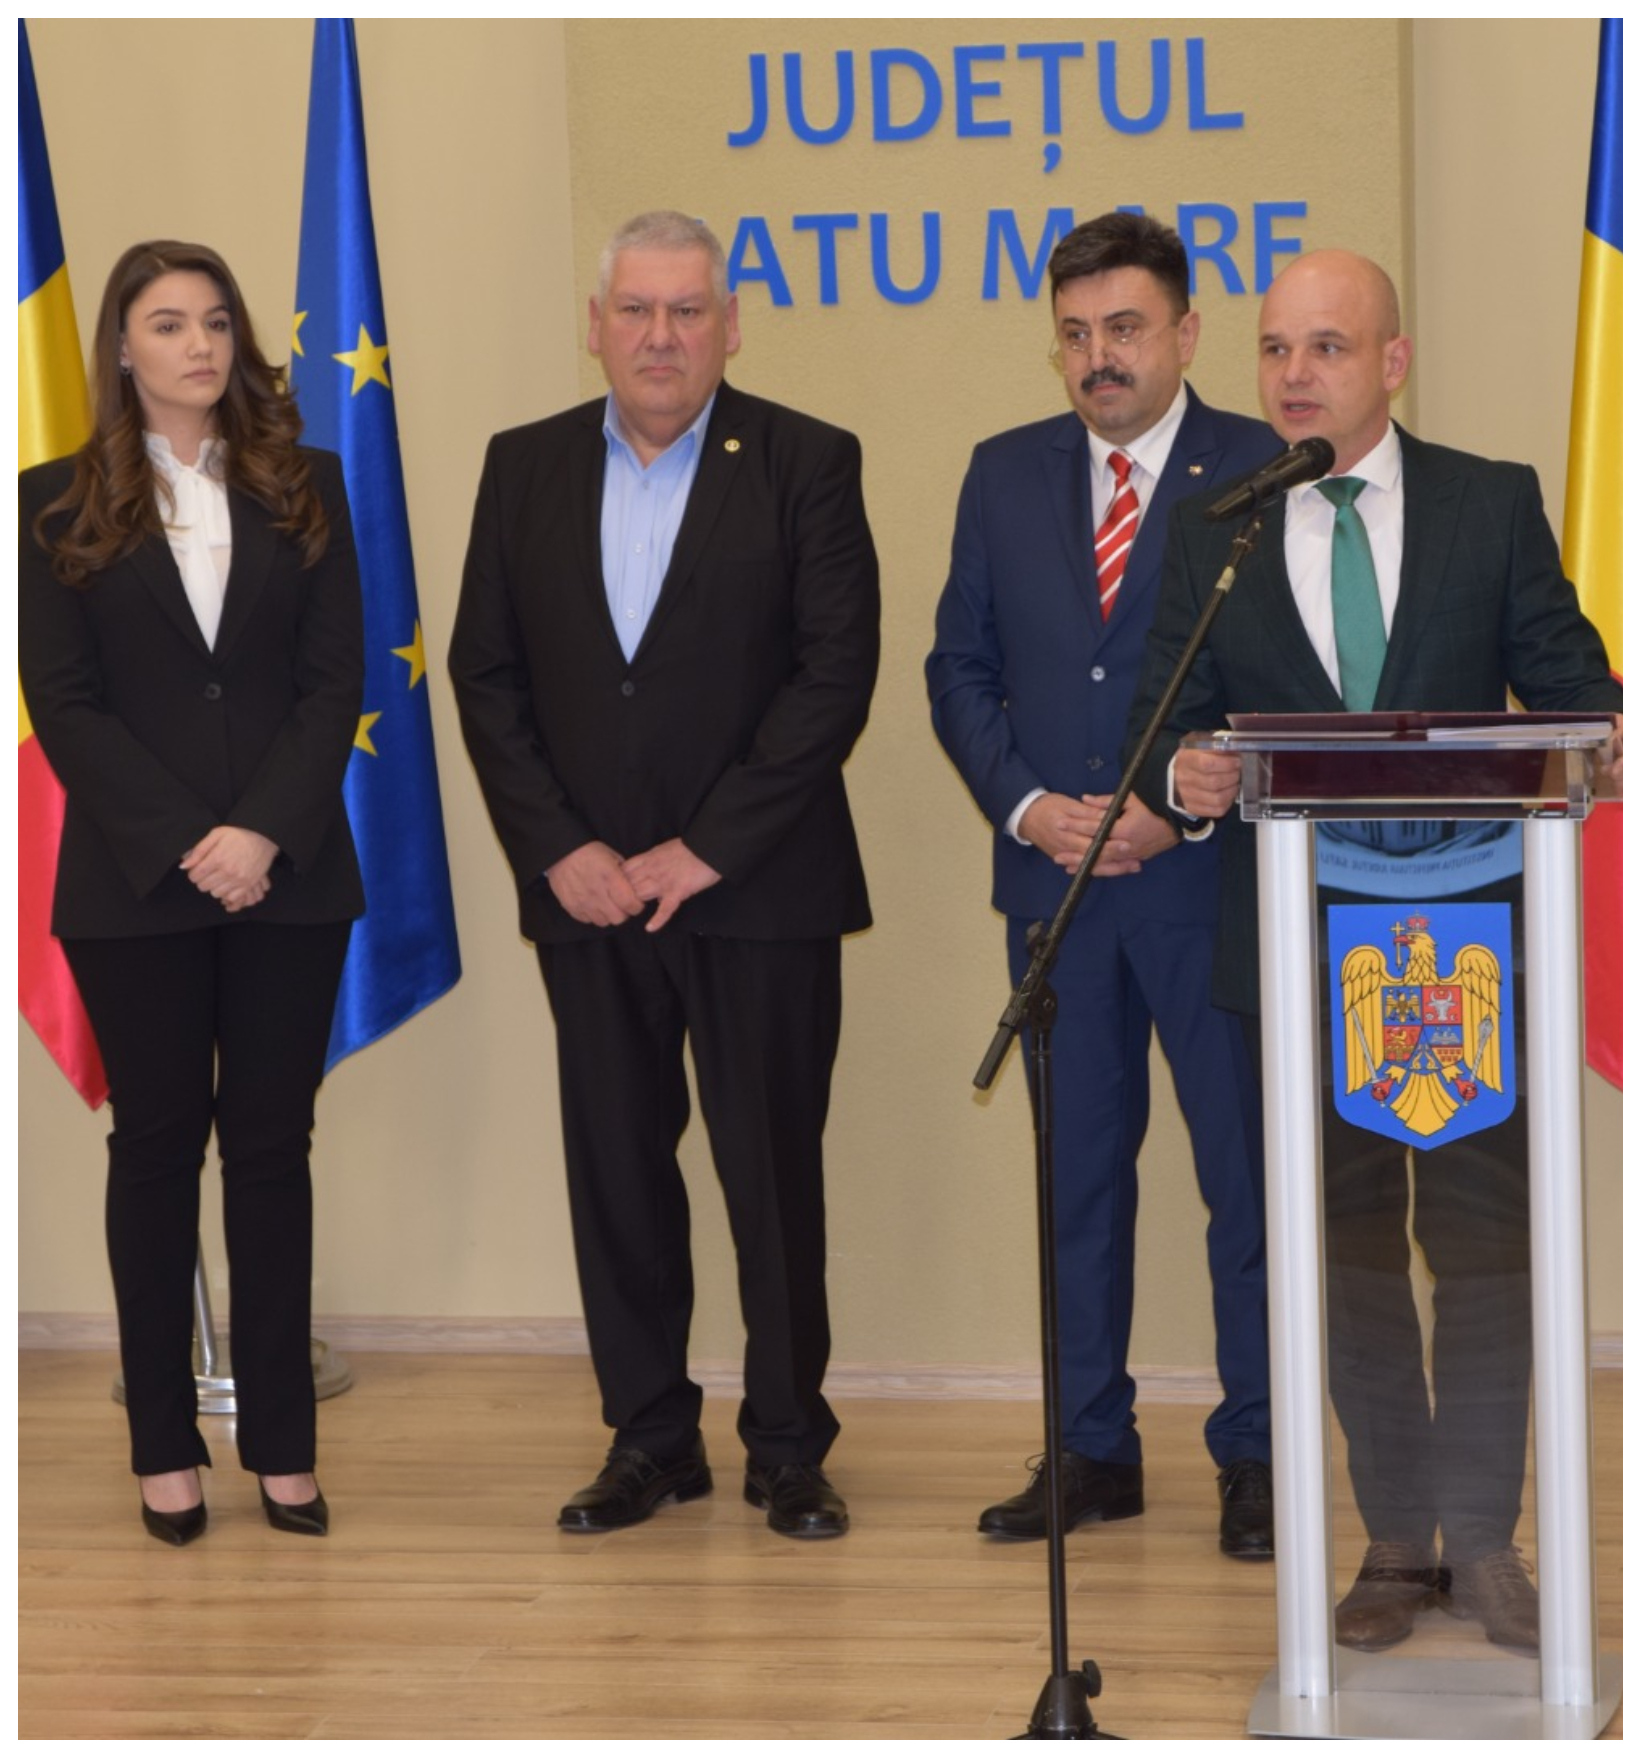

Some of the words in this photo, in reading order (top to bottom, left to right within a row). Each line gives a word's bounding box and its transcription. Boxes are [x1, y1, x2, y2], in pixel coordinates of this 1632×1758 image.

[727, 37, 1244, 173] JUDEȚUL
[695, 211, 941, 307] ATU
[981, 201, 1308, 301] MRE
